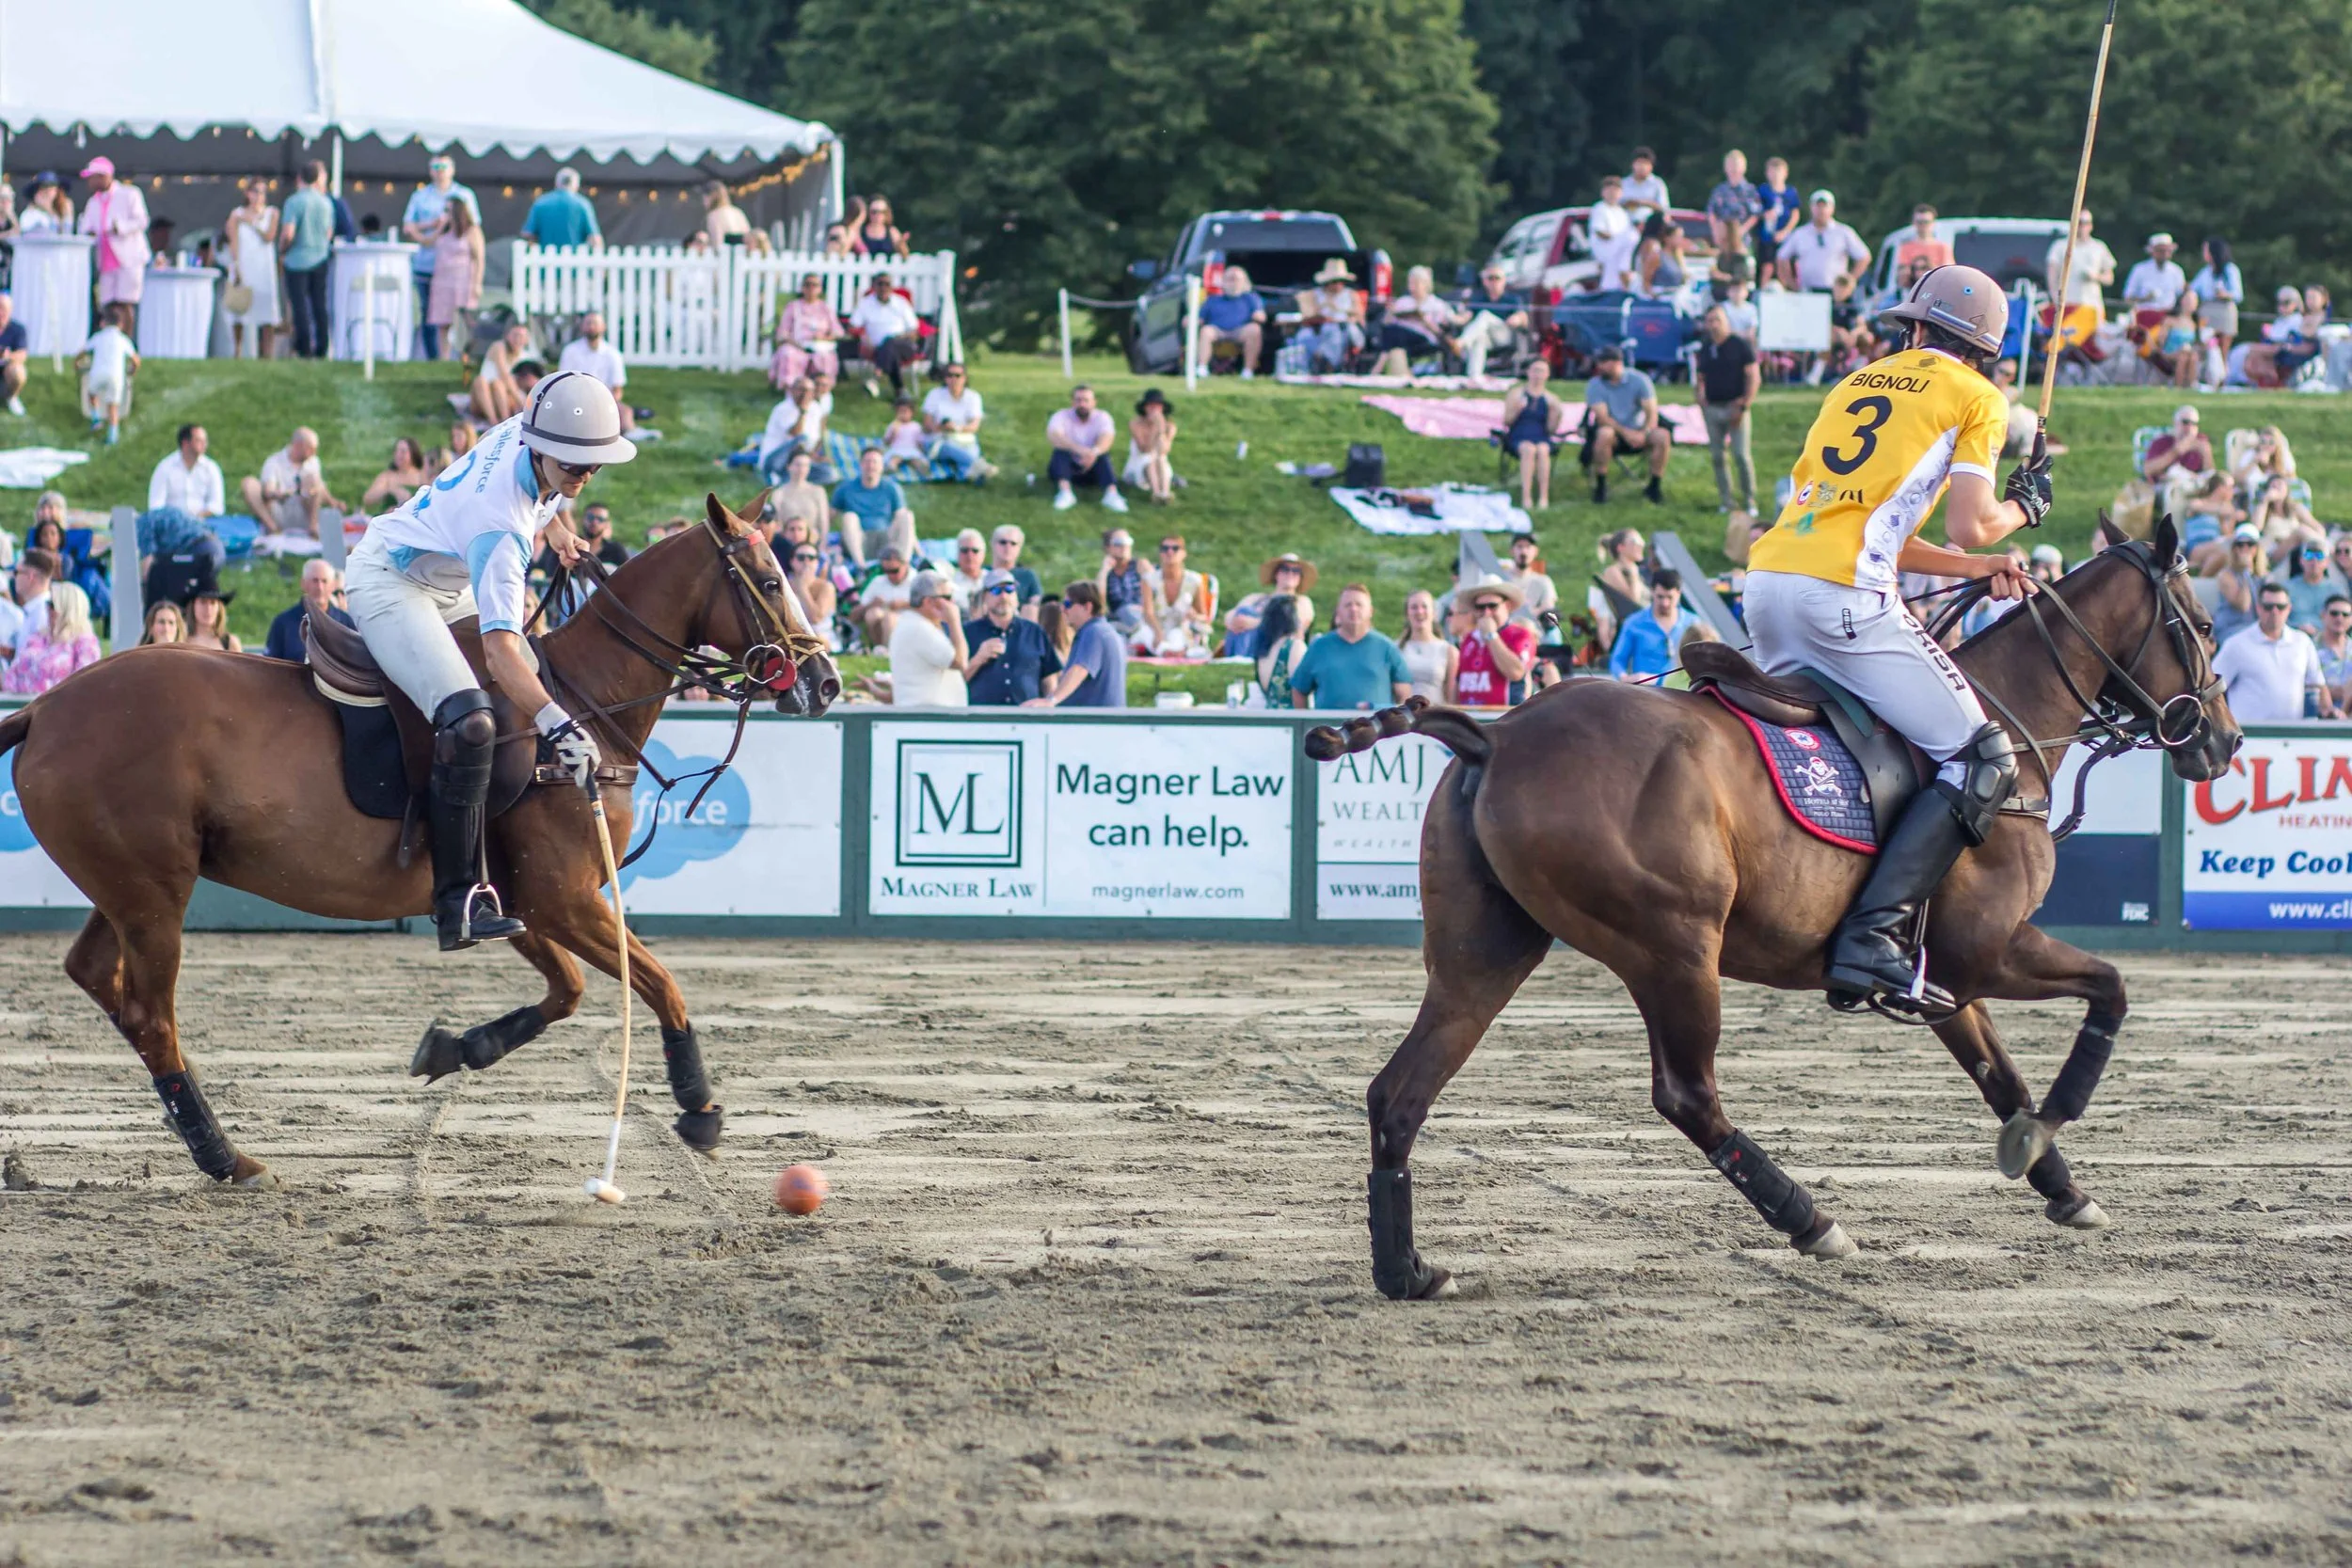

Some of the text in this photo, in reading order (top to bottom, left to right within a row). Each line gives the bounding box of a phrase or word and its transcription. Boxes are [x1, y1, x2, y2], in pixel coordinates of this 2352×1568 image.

[1850, 372, 1931, 393] BIGNOLI
[1821, 395, 1893, 476] 3
[913, 772, 1005, 835] ML
[1056, 763, 1284, 805] Magner Law
[1088, 815, 1249, 857] can help.
[2200, 849, 2352, 879] Keep Cool
[1091, 882, 1245, 901] magnerlaw.com
